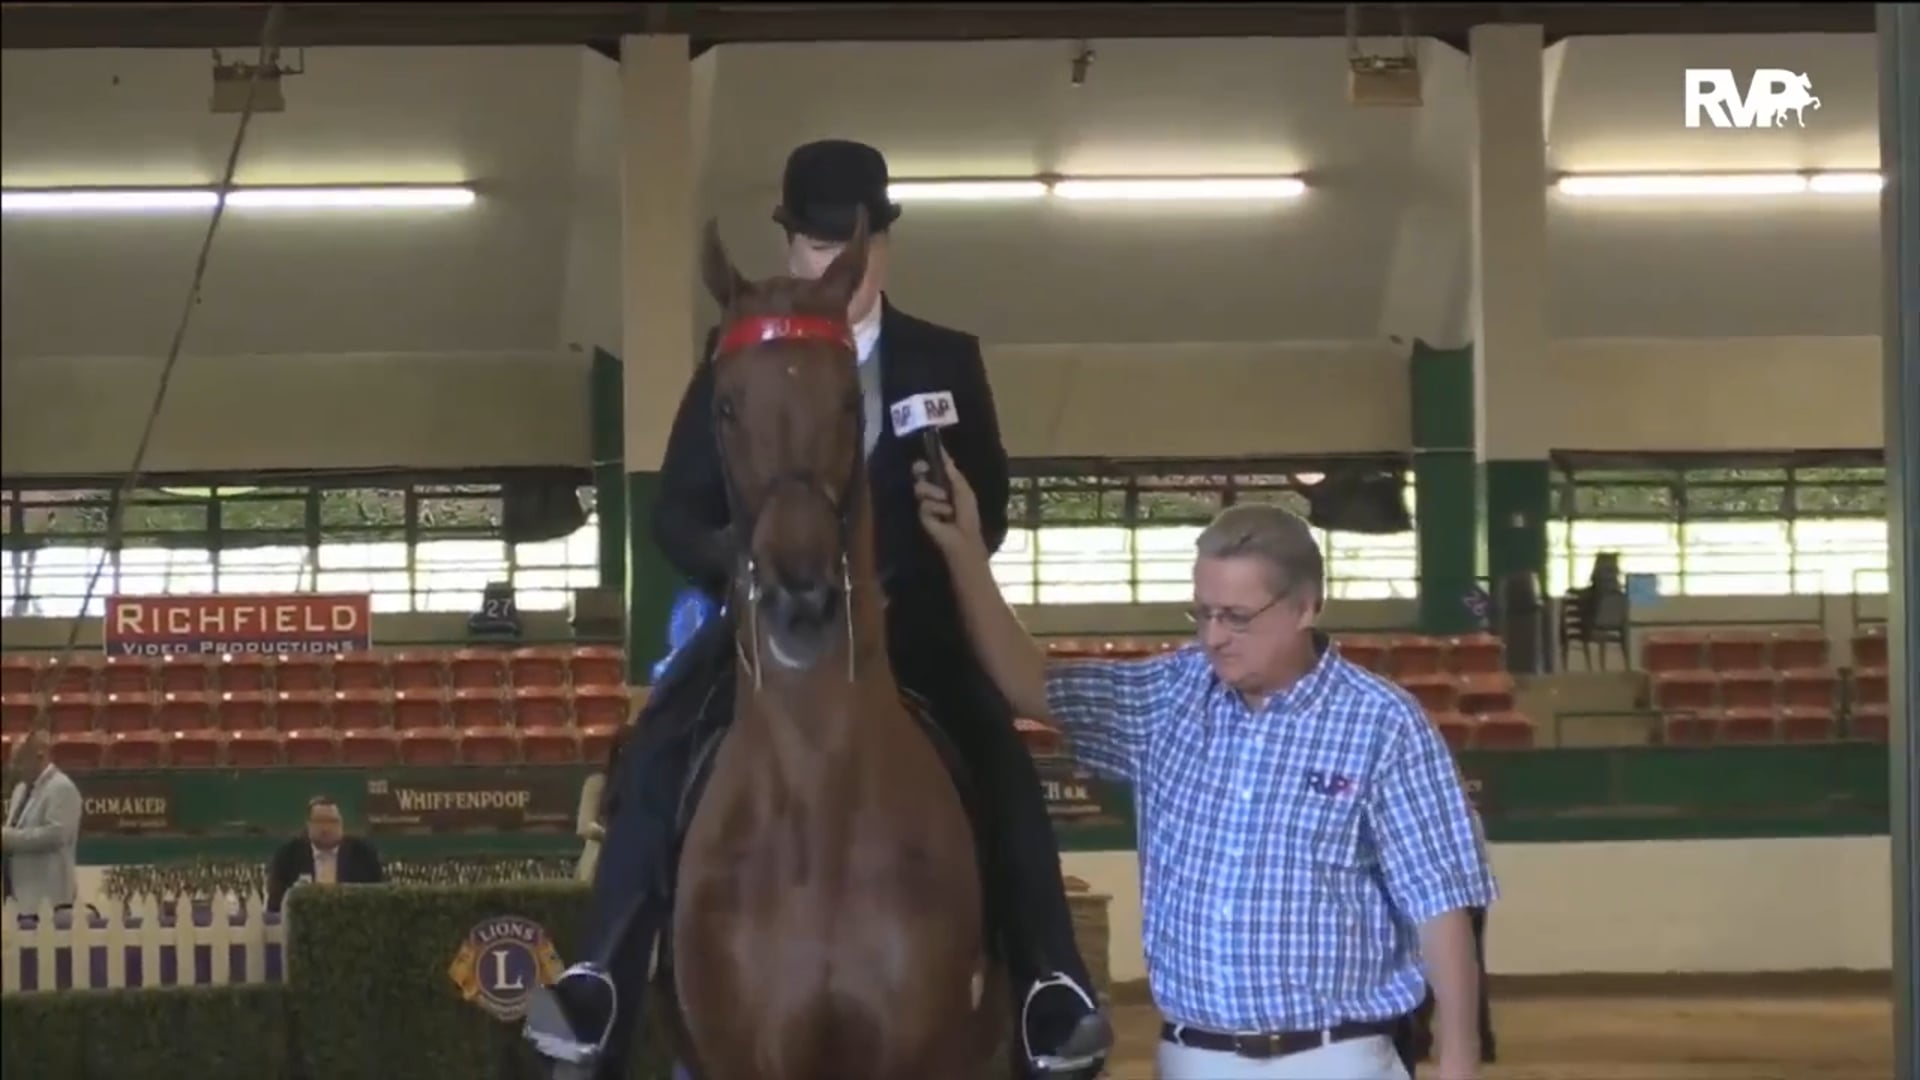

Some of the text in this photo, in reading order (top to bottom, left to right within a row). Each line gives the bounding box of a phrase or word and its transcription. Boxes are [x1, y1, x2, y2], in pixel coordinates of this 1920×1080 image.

[486, 598, 512, 617] 27
[116, 603, 358, 635] RICHFIELD
[121, 640, 353, 656] VIDEO PRODUCTIONS
[84, 797, 167, 816] CHMAKER
[478, 921, 535, 942] LIONS
[491, 950, 524, 990] L
